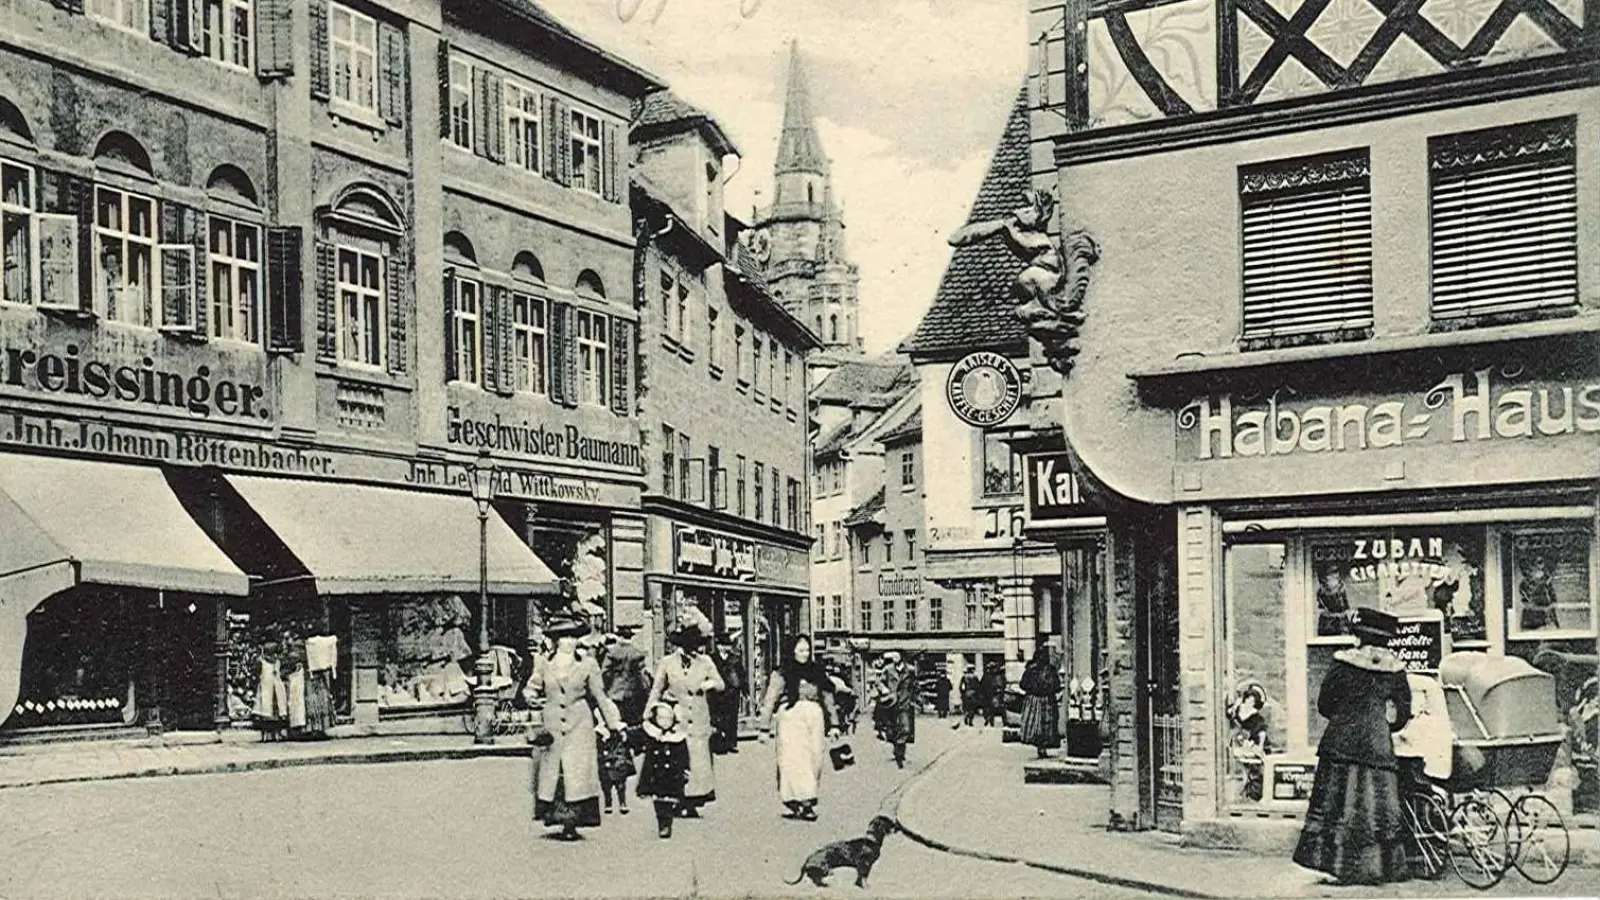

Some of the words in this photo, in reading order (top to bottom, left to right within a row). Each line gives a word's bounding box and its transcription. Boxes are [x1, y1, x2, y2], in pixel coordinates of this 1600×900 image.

[0, 344, 270, 418] reissinger.
[446, 405, 564, 458] Geschwister
[565, 424, 643, 469] Baumann
[1353, 536, 1444, 559] ZUBAN
